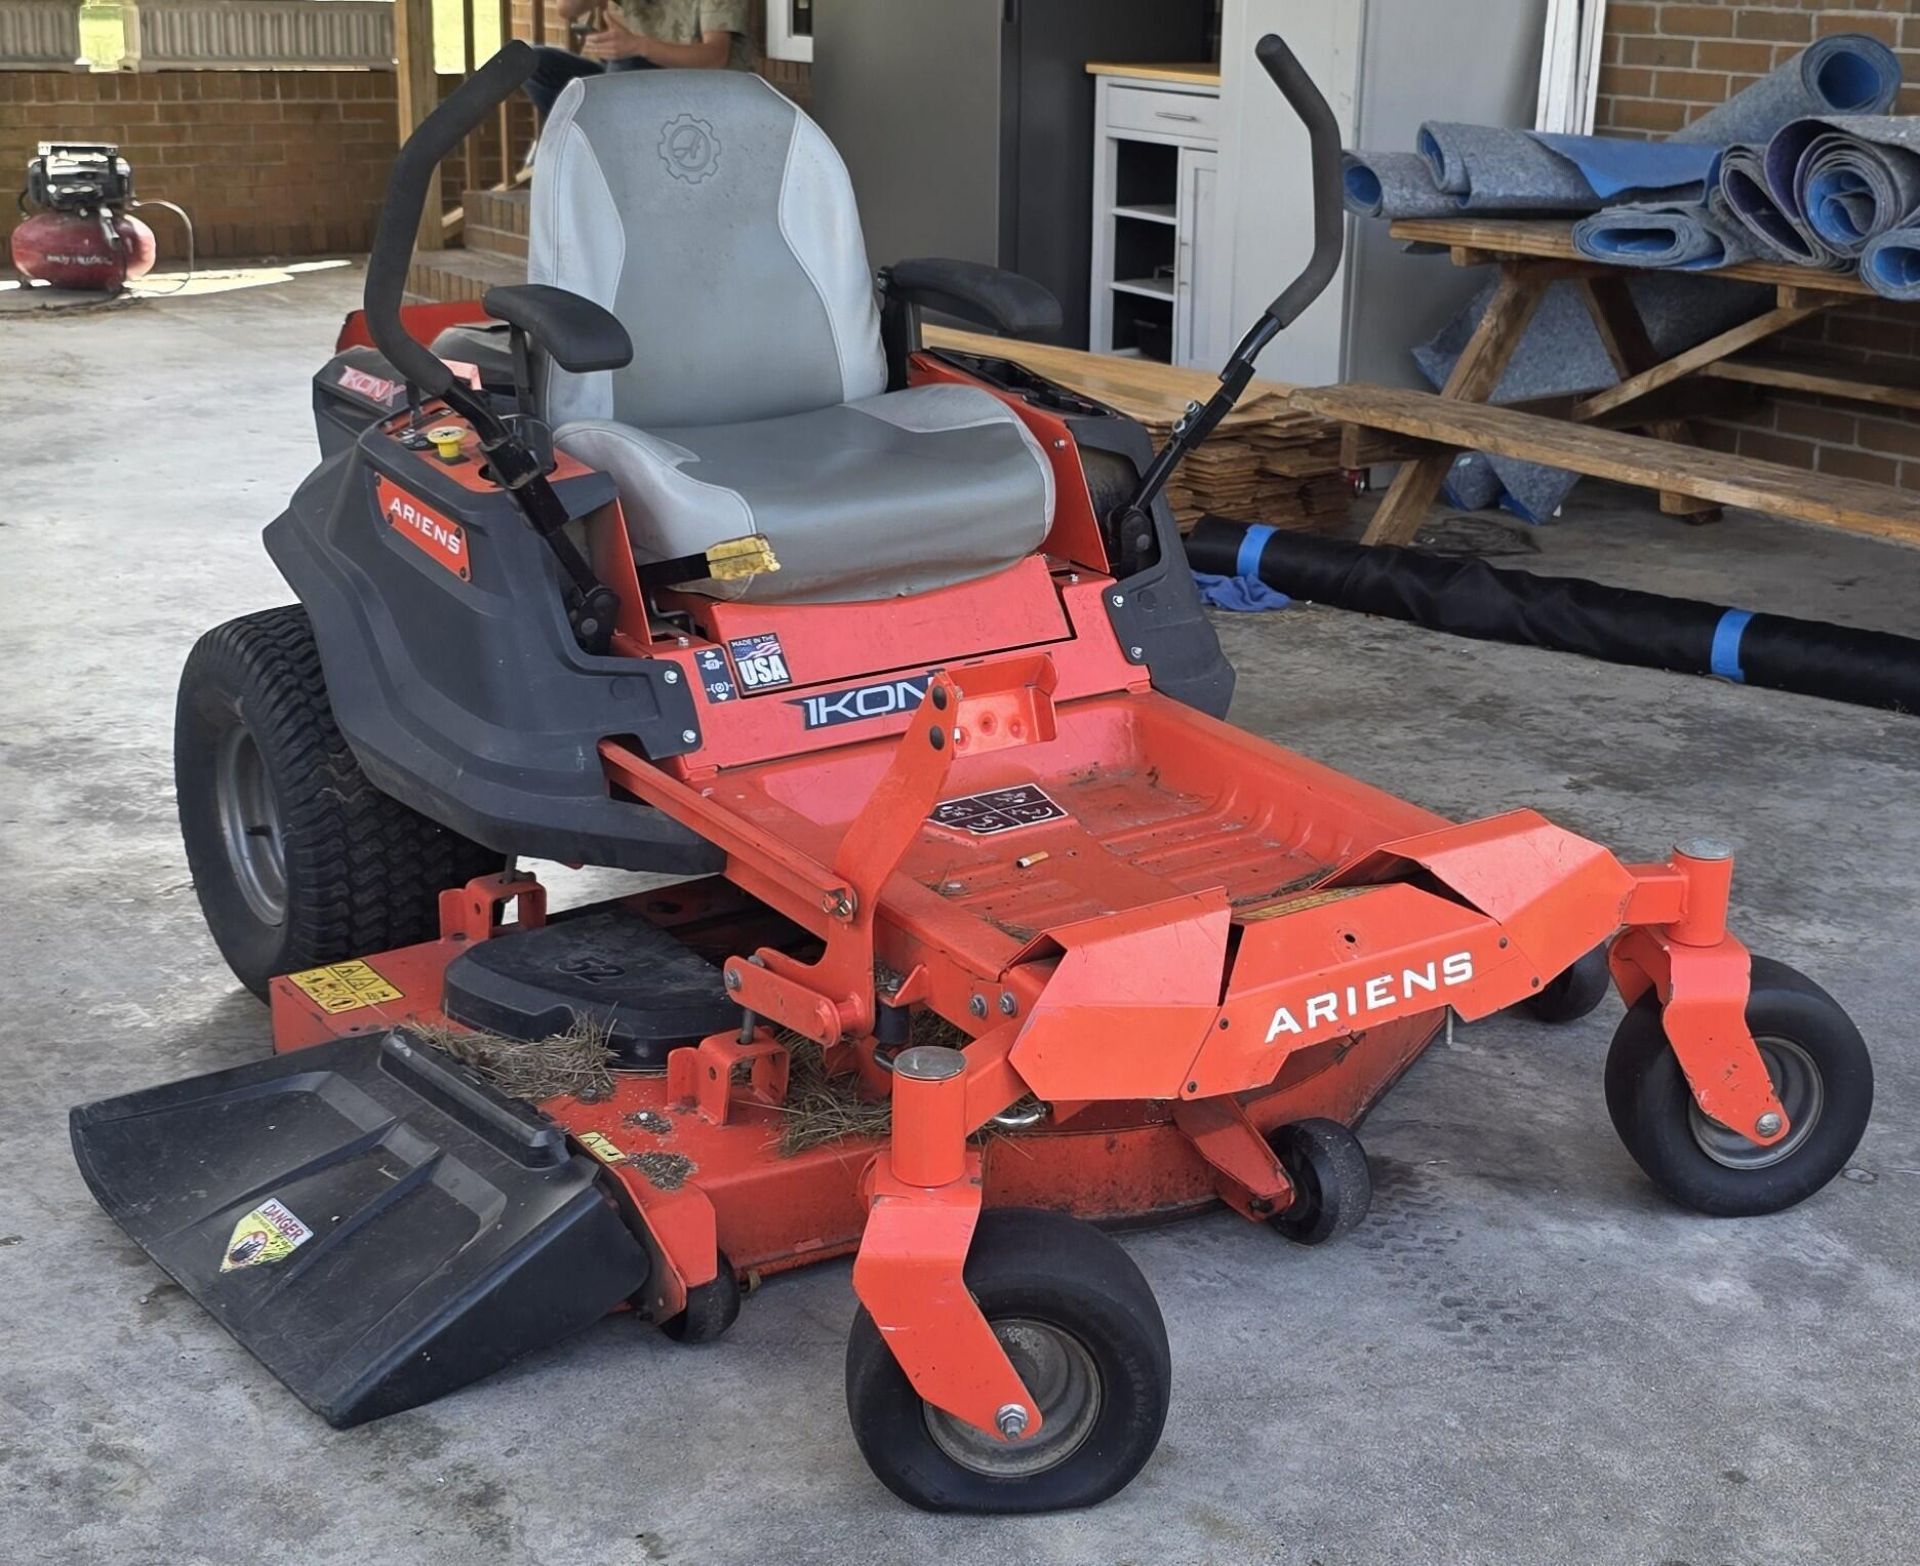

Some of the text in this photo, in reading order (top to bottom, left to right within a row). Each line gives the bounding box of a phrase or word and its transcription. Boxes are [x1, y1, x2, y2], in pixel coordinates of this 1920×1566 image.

[390, 497, 461, 555] ARIENS
[731, 639, 753, 648] MADE
[738, 655, 789, 686] USA
[1264, 951, 1473, 1044] ARIENS
[262, 1204, 304, 1242] DANGER
